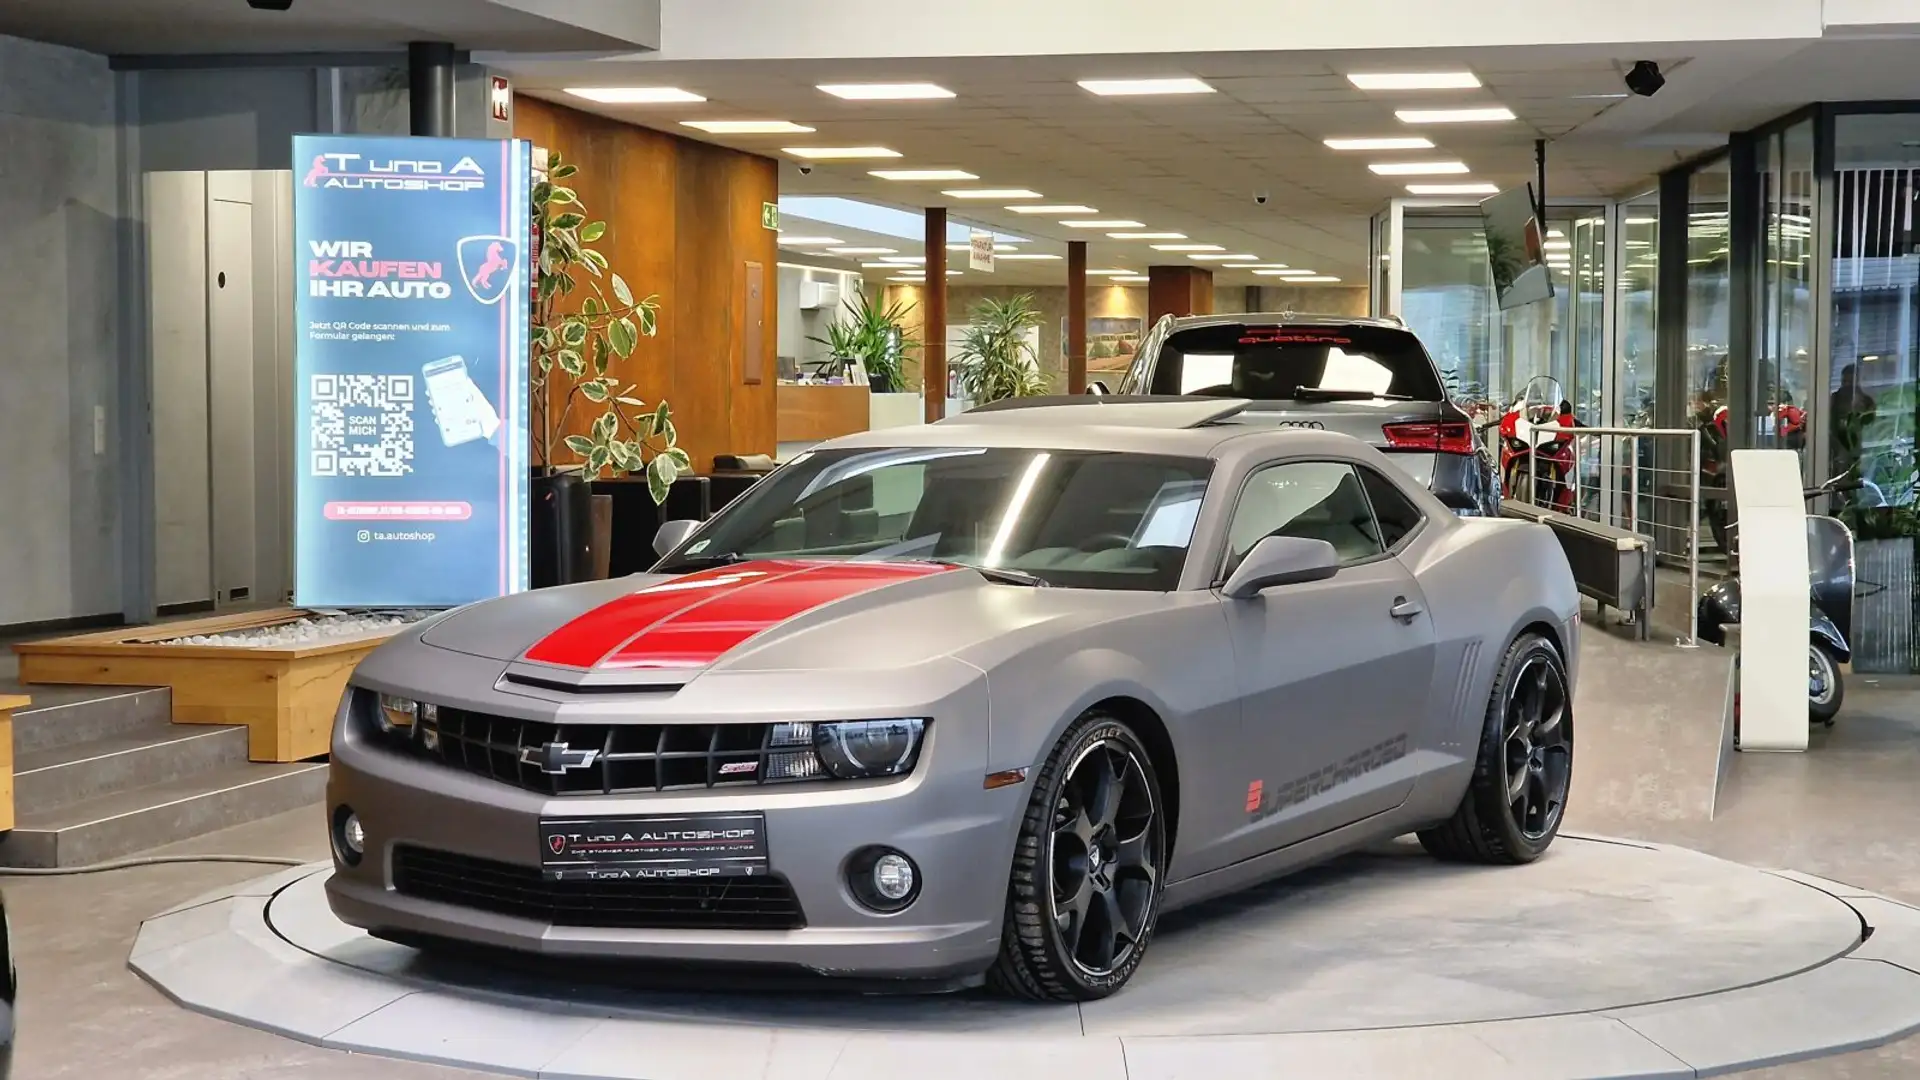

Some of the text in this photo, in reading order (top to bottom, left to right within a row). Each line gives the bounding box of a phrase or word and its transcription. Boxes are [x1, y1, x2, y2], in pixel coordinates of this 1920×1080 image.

[324, 153, 361, 171] T
[448, 156, 485, 175] A
[324, 177, 485, 191] AUTOSHOP
[308, 240, 373, 258] WIR
[309, 260, 442, 278] KAUFEN
[309, 280, 452, 299] IHR AUTO
[309, 321, 331, 330] Jetzt
[332, 321, 347, 331] QR
[348, 322, 371, 330] Code
[373, 323, 410, 331] scannen
[411, 323, 430, 331] und
[309, 331, 350, 340] Formular
[1238, 335, 1352, 344] quattro
[349, 416, 377, 425] SCAN
[349, 426, 377, 436] MICH
[374, 530, 435, 543] ta.autoshop
[568, 834, 581, 842] T
[621, 833, 635, 841] A
[640, 829, 755, 841] AUTOSHOP
[587, 871, 597, 879] T
[620, 870, 631, 879] A
[635, 867, 720, 879] AUTOSHOP
